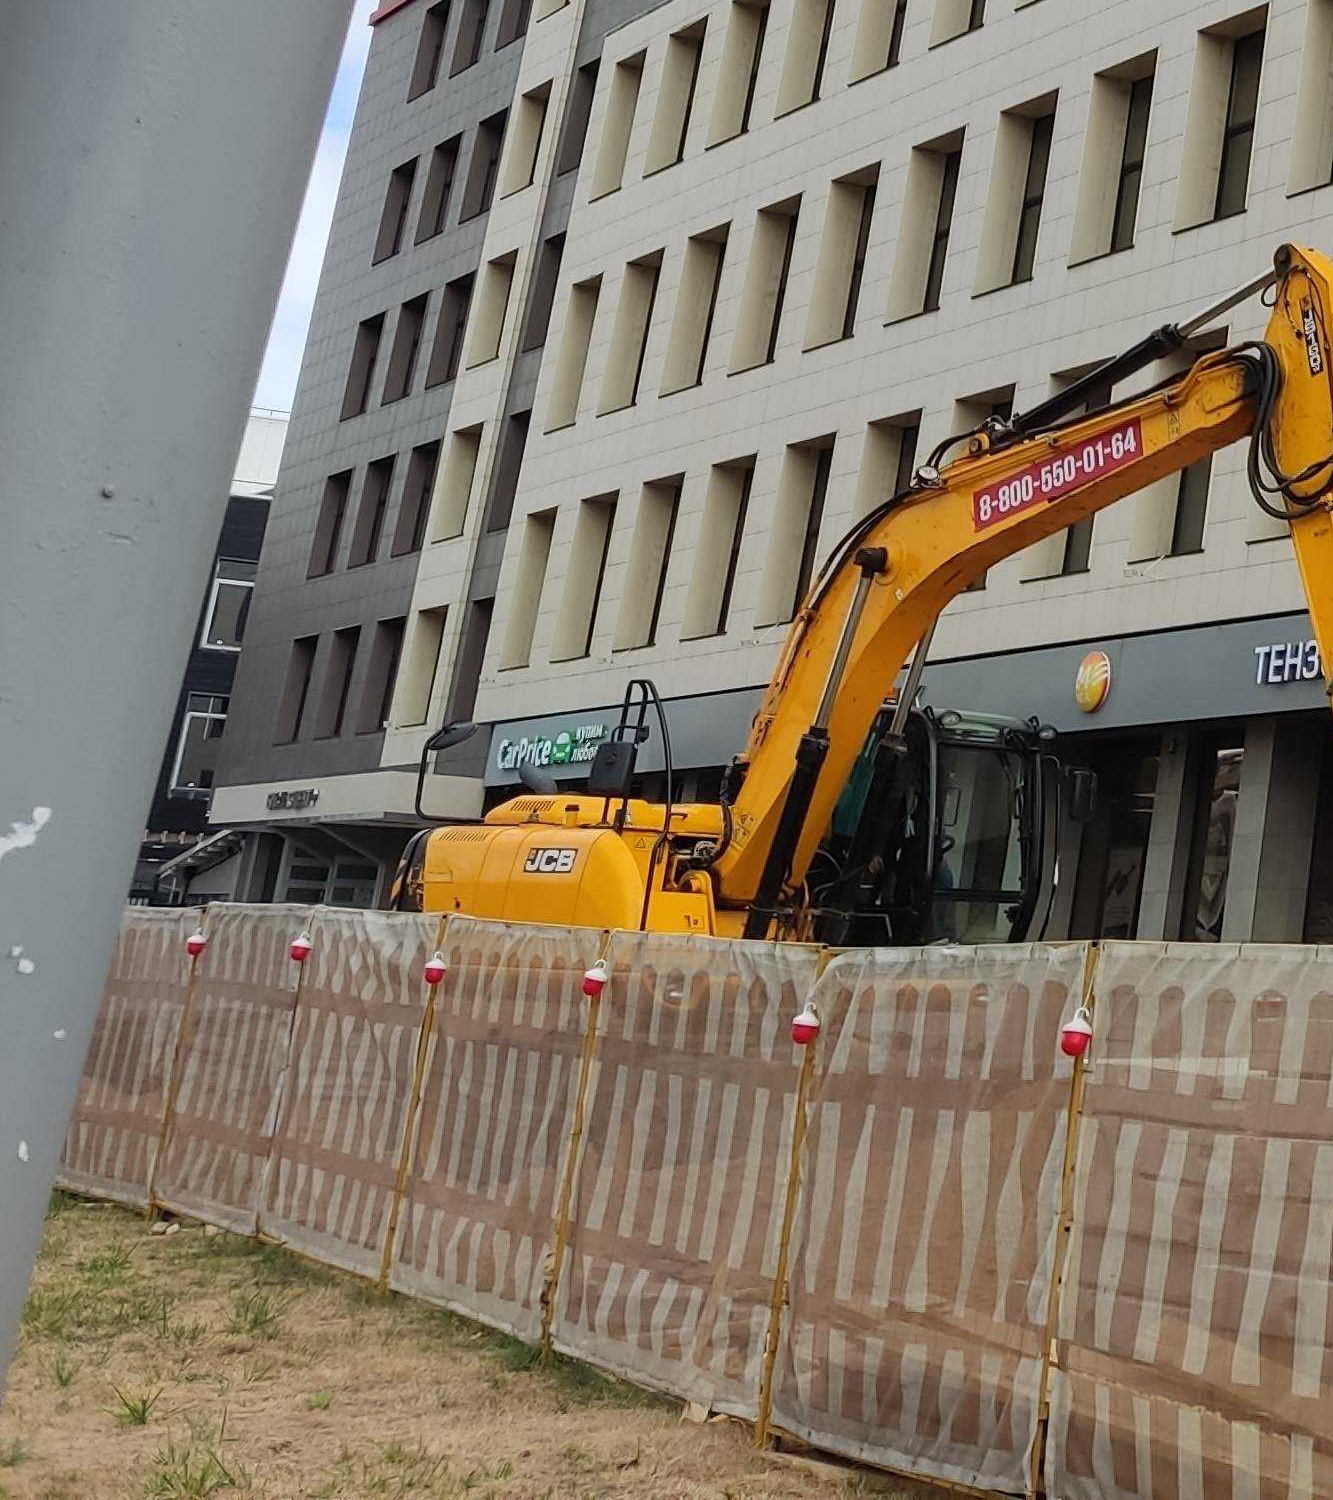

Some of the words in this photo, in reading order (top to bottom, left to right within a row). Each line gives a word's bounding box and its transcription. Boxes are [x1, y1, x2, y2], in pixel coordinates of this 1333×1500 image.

[978, 425, 1138, 522] 8-800-550-01-64
[1254, 639, 1325, 685] ТЕНЗ
[496, 734, 553, 770] CarPrice
[525, 848, 578, 872] JCB
